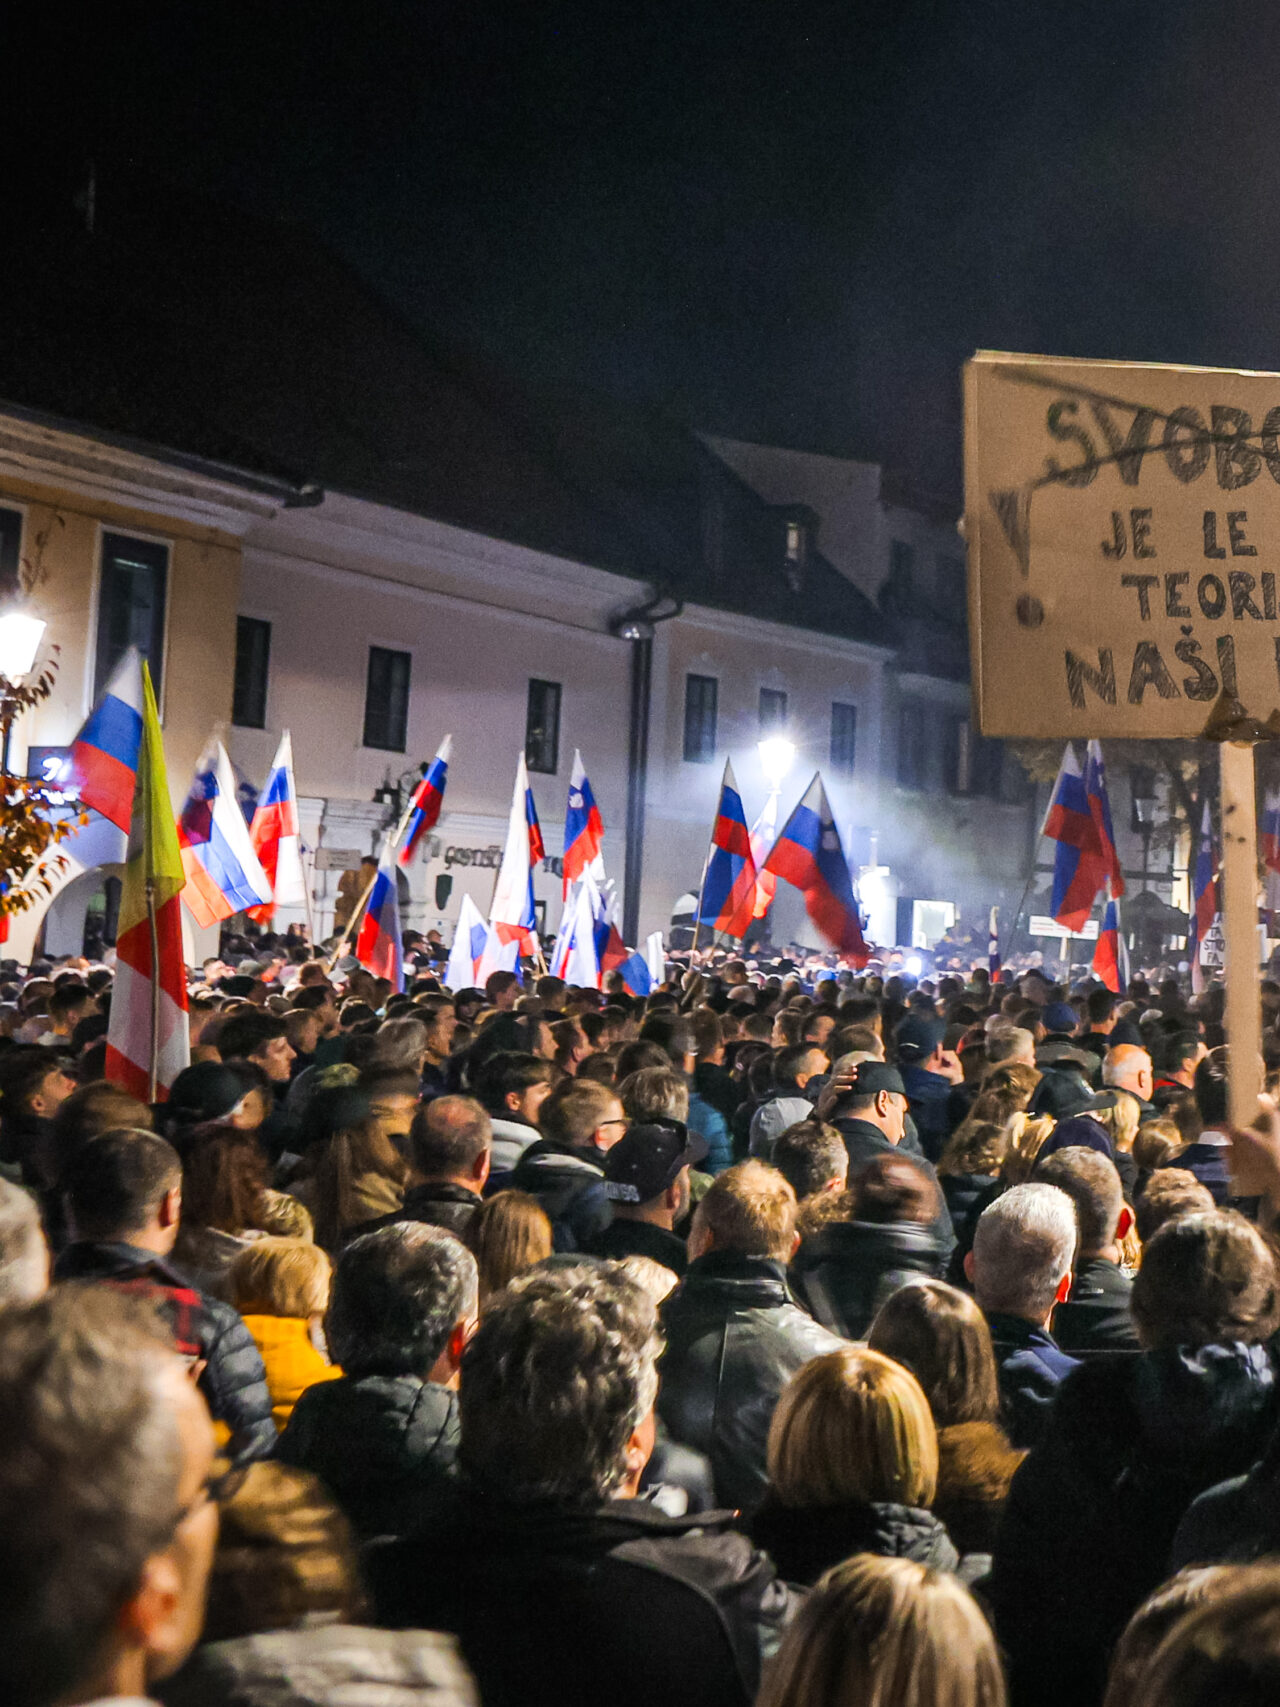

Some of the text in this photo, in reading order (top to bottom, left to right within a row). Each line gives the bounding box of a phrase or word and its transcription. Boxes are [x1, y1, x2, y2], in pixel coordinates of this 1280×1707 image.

[1101, 507, 1157, 560] JE
[1203, 510, 1257, 559] LE
[1063, 624, 1239, 709] NAŠI
